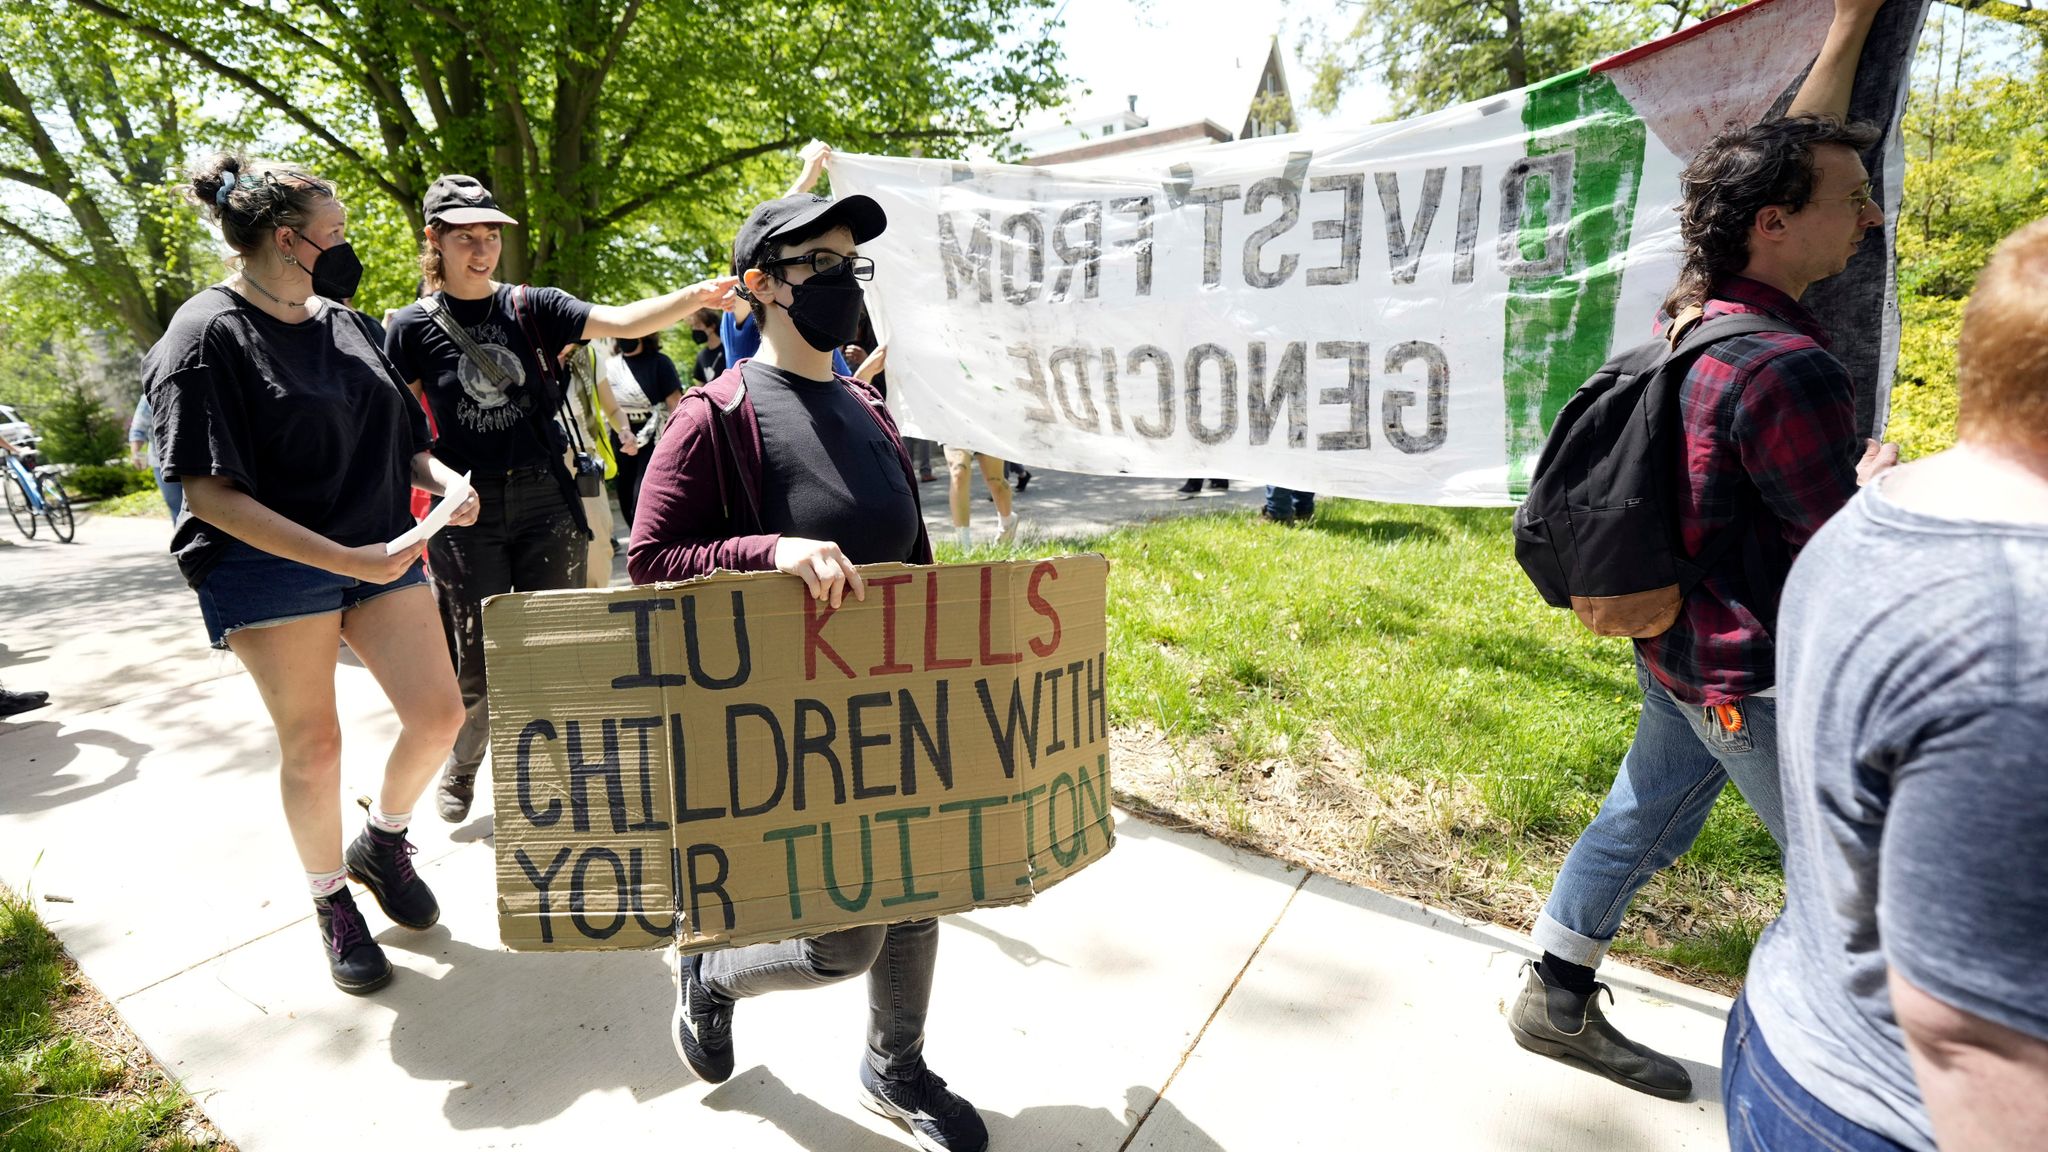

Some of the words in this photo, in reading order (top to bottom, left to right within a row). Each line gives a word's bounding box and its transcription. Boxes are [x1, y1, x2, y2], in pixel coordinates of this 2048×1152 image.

[608, 590, 752, 690] IU
[803, 561, 1062, 681] KILLS
[515, 679, 954, 835] CHILDREN
[974, 652, 1107, 779] WITH
[514, 842, 736, 944] YOUR
[763, 753, 1111, 920] TUITION
